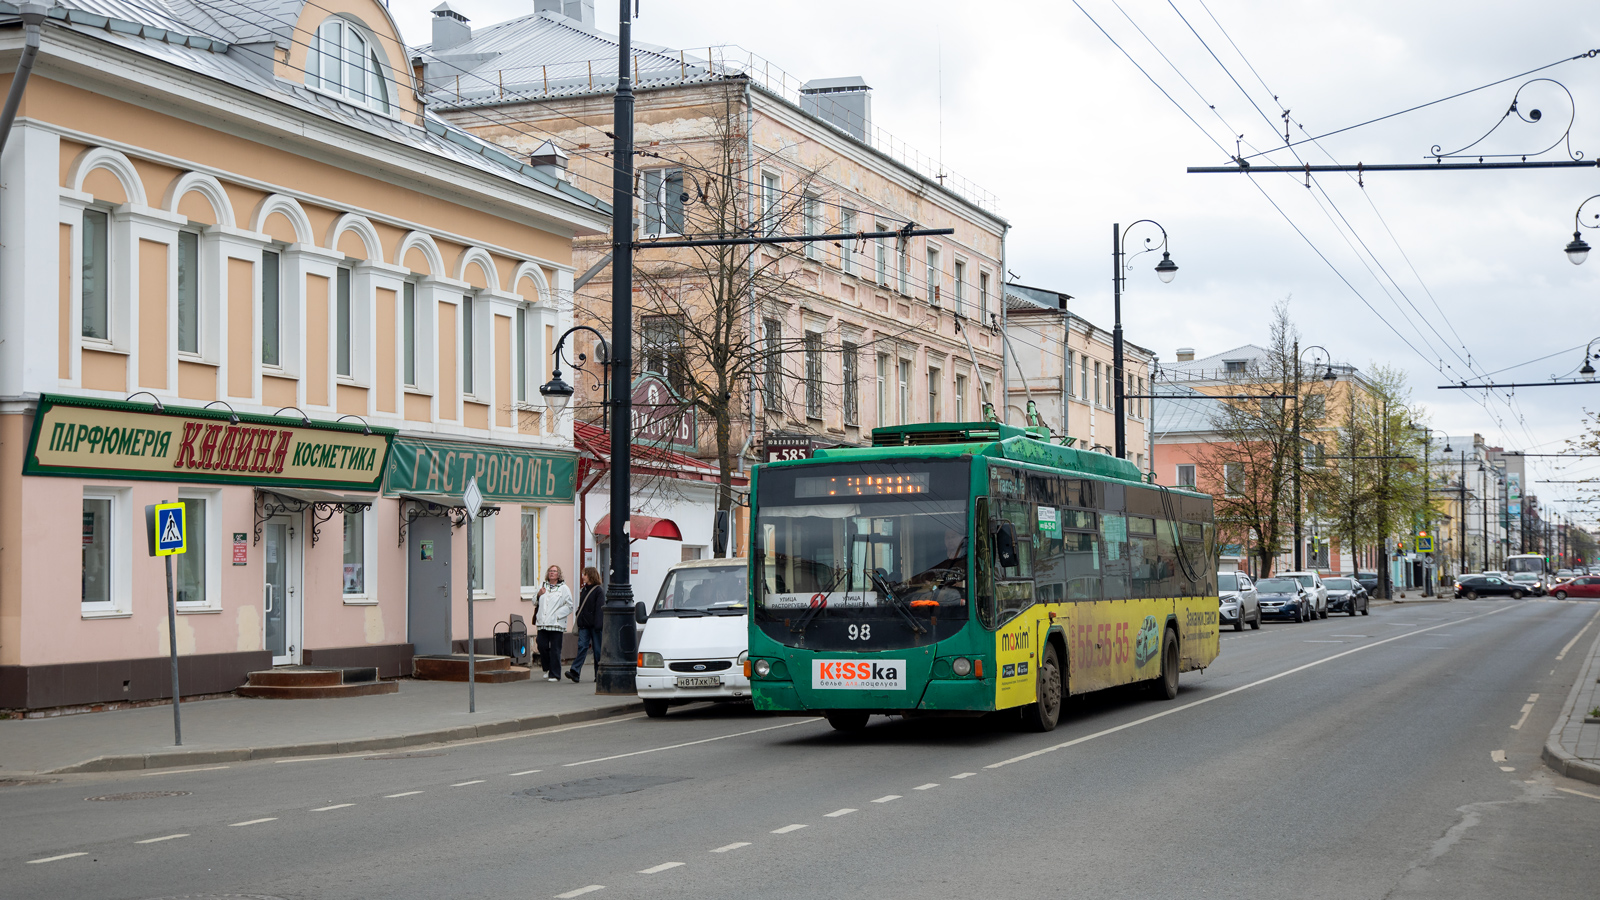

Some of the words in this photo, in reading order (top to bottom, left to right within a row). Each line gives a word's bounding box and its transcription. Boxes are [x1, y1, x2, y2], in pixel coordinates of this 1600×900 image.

[48, 421, 173, 458] ПАРФЮМЕРІЯ
[173, 420, 293, 474] КАЛИНА
[782, 448, 806, 461] 585
[291, 440, 377, 472] КОСМЕТИКА
[411, 448, 556, 496] ГАСТРОНОМЪ
[847, 623, 871, 641] 98
[1001, 626, 1029, 652] maxim
